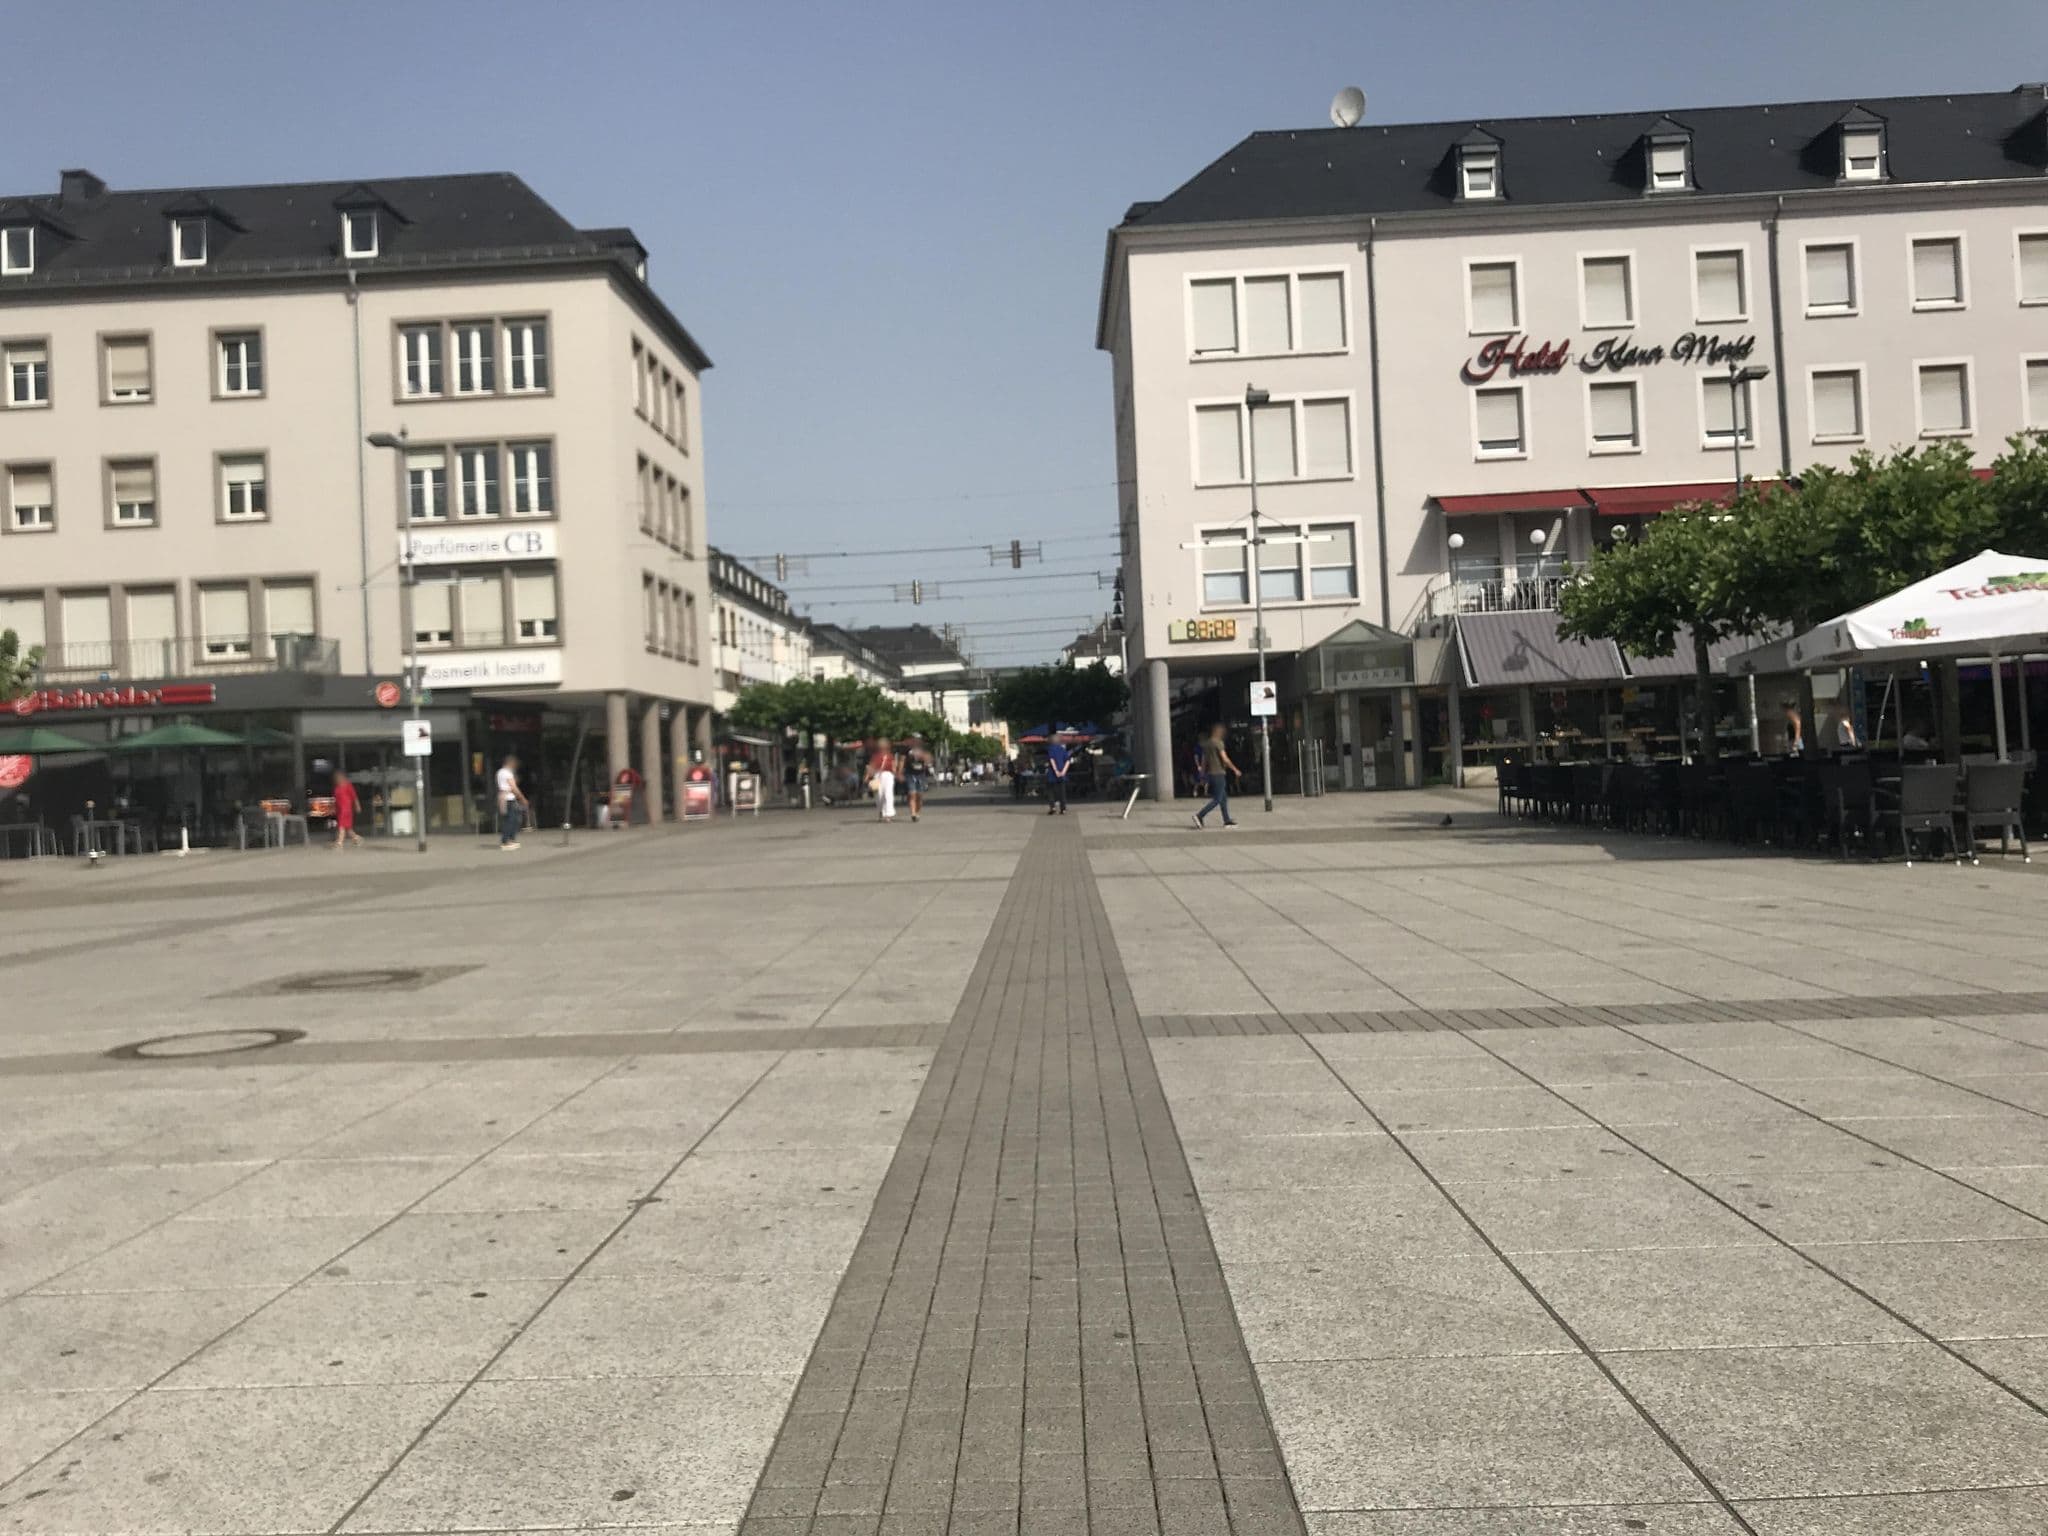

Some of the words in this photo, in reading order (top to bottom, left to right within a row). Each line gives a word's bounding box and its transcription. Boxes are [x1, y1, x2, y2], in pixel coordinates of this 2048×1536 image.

[1463, 335, 1570, 381] Hotel
[504, 531, 543, 554] CB
[496, 660, 545, 677] Institut
